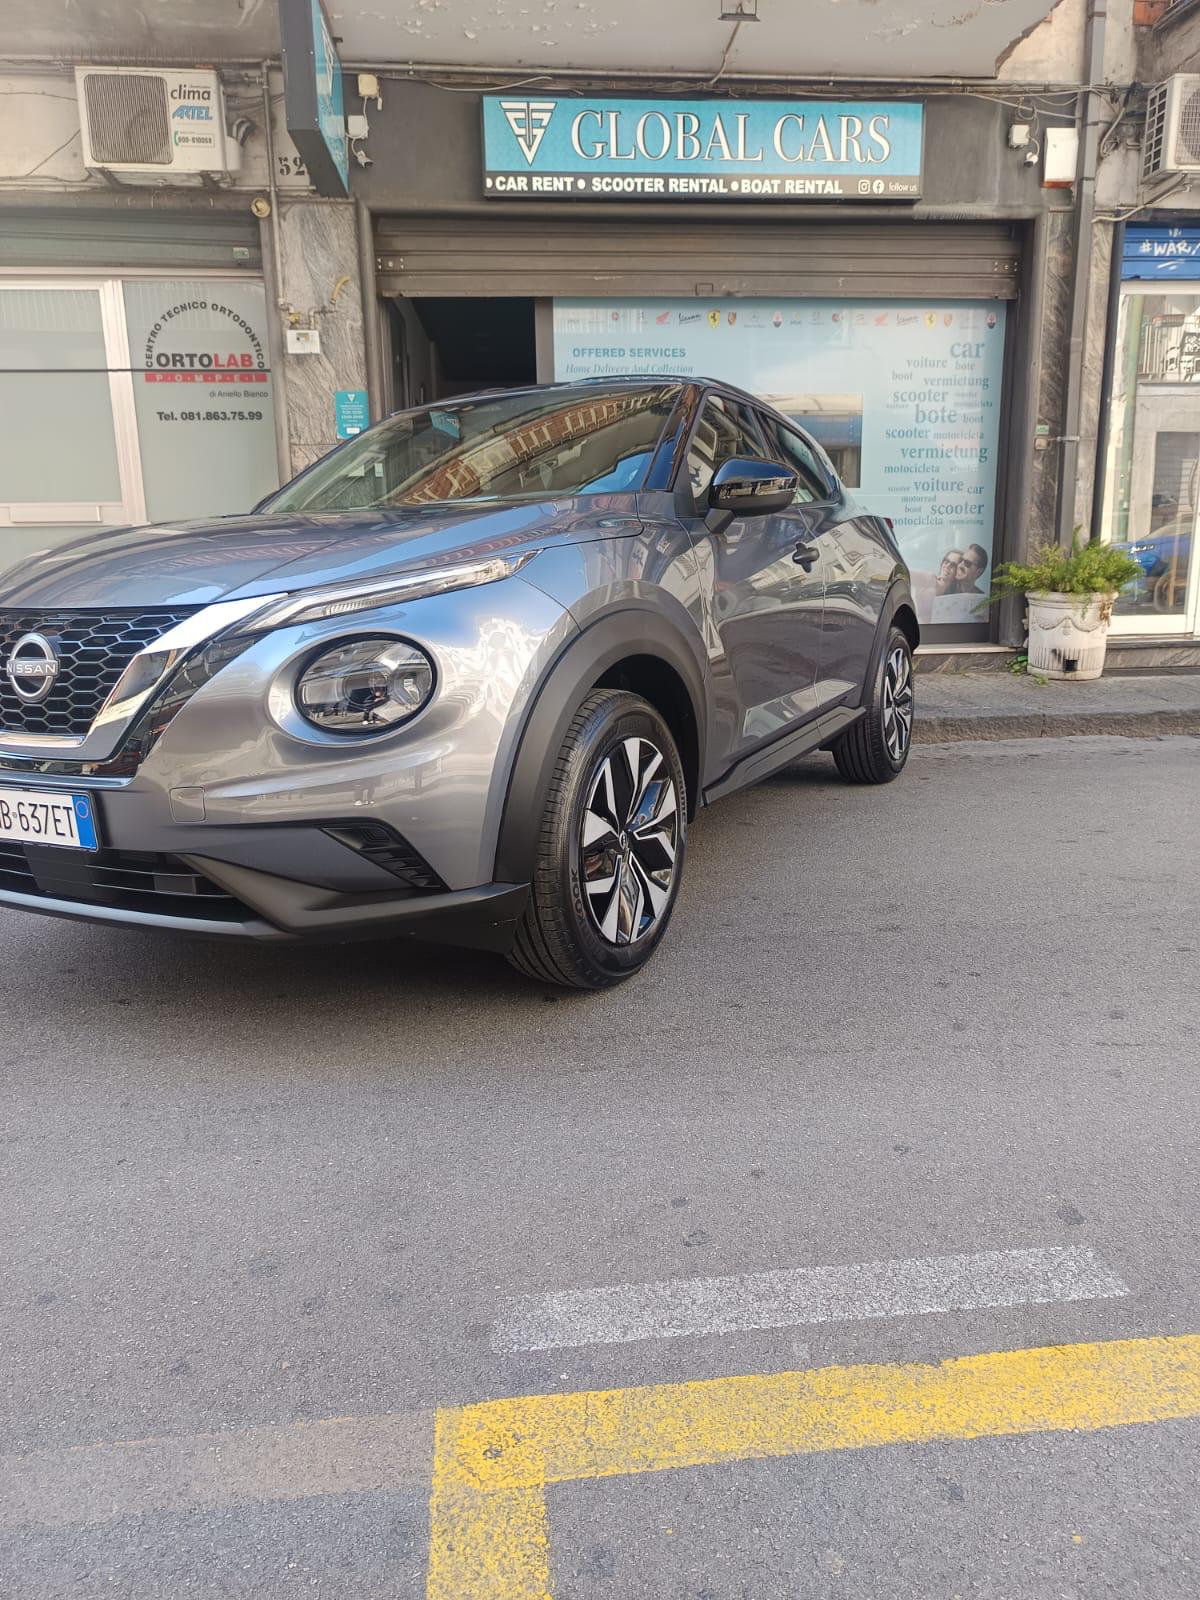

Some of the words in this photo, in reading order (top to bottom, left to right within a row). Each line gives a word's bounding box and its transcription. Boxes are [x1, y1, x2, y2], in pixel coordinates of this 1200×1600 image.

[170, 84, 211, 101] clima
[172, 105, 212, 121] ARTEL
[571, 109, 763, 161] GLOBAL
[773, 113, 891, 164] CARS
[495, 176, 528, 191] CAR
[532, 176, 574, 191] RENT
[592, 177, 665, 192] SCOOTER
[669, 178, 728, 193] RENTAL
[741, 179, 781, 193] BOAT
[785, 179, 843, 194] RENTAL
[888, 182, 909, 192] follow
[910, 184, 918, 192] us
[145, 323, 162, 368] CENTRO
[161, 301, 207, 322] TECNICO
[211, 303, 265, 369] ORTODONTICO
[573, 348, 626, 358] OFFERED
[629, 348, 687, 358] SERVICES
[950, 342, 985, 358] car
[156, 353, 253, 368] ORTOLAB
[906, 356, 948, 368] voiture
[566, 364, 591, 373] Home
[593, 364, 630, 375] Delivery
[631, 364, 649, 373] And
[651, 363, 695, 374] Collection
[893, 389, 949, 402] scooter
[157, 411, 177, 421] Tel.
[180, 411, 263, 421] 081.863.75.99
[915, 403, 957, 423] bote
[885, 428, 930, 438] scooter
[900, 443, 989, 463] vermietung
[884, 463, 940, 473] motocicleta
[914, 478, 964, 491] voiture
[967, 486, 984, 495] car
[930, 502, 984, 515] scooter
[7, 662, 56, 674] NISSAN
